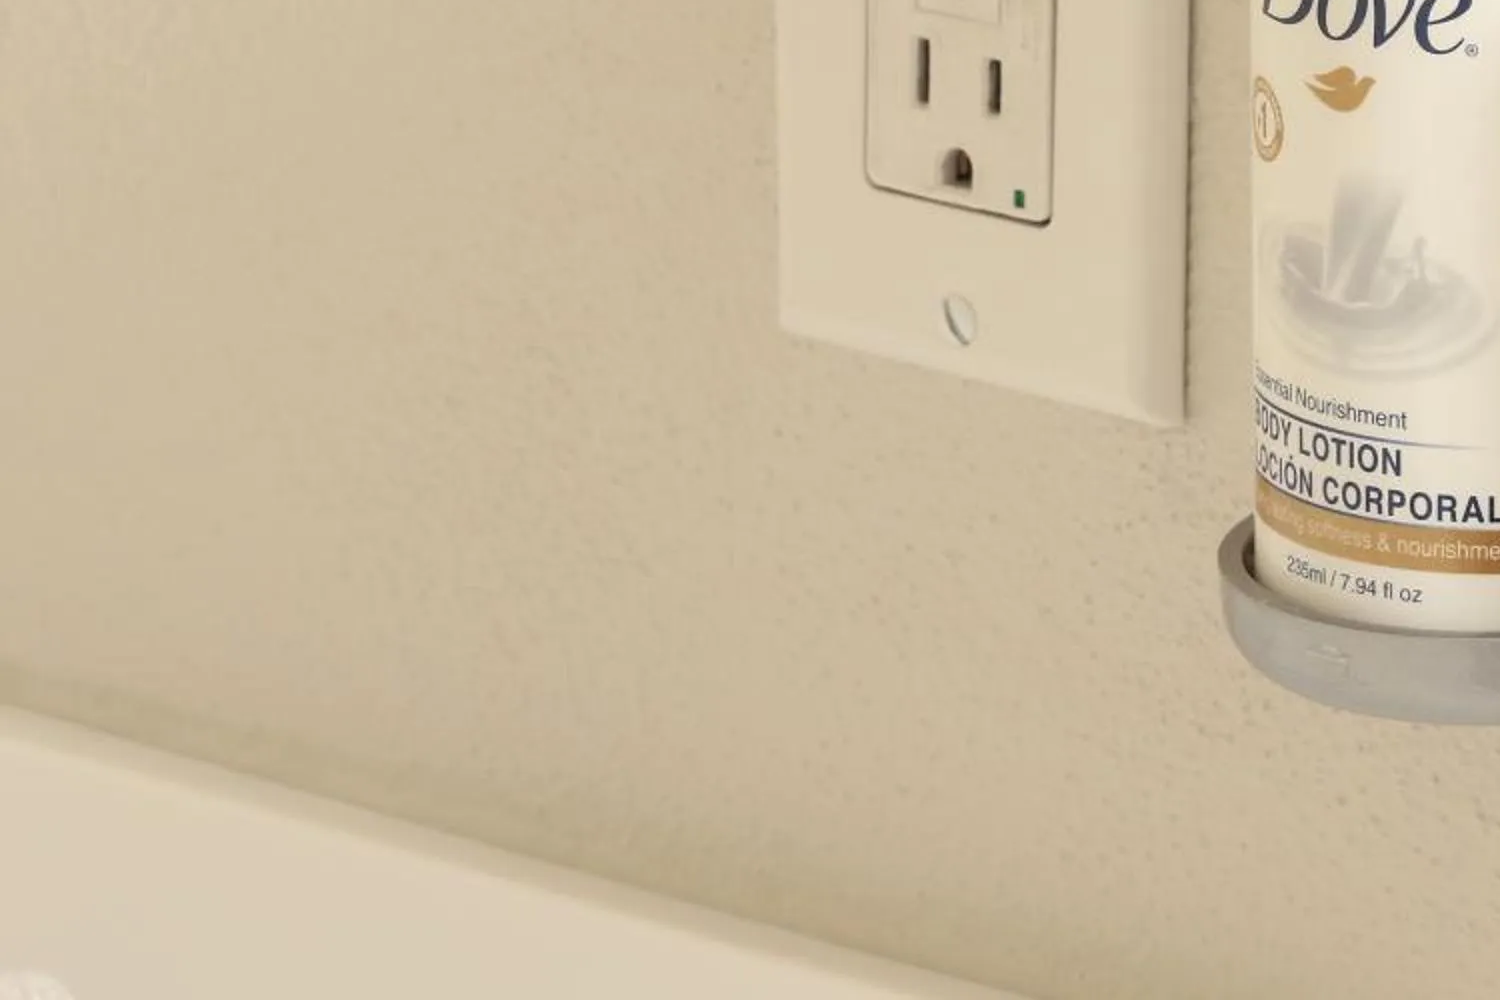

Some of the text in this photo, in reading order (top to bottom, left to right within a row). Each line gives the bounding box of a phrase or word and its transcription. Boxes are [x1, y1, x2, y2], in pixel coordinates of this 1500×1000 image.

[1295, 386, 1409, 431] Nourishment
[1299, 426, 1402, 477] LOTION
[1376, 530, 1391, 554] &
[1286, 554, 1327, 585] 235ml
[1340, 573, 1377, 597] 7.94
[1383, 581, 1394, 600] fl
[1399, 587, 1424, 604] oz
